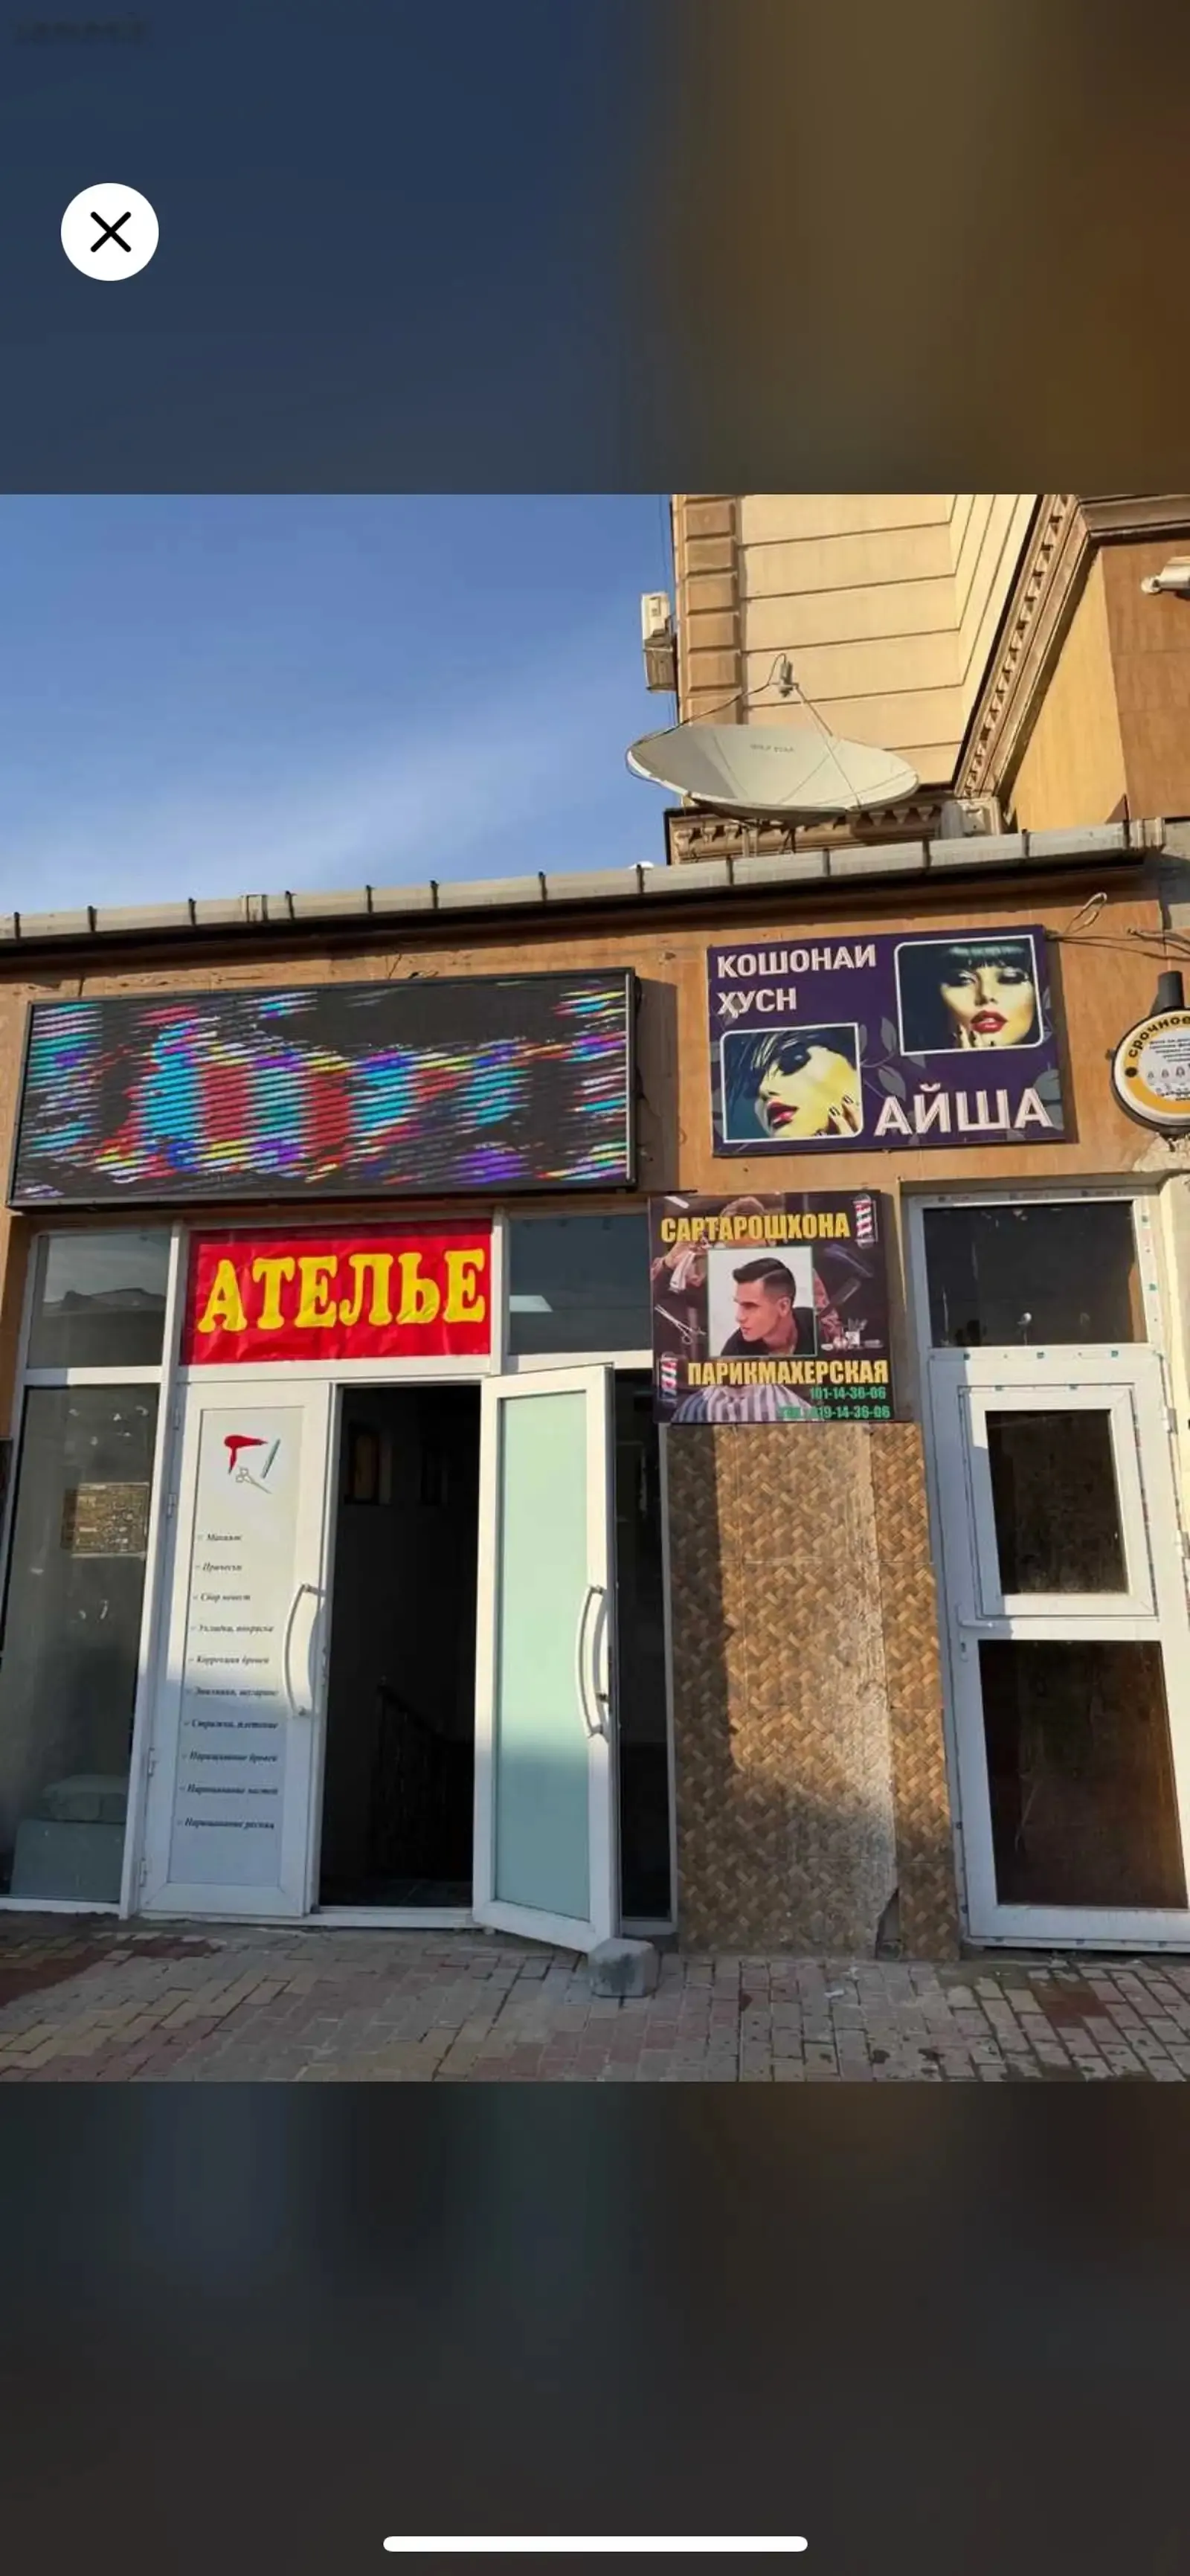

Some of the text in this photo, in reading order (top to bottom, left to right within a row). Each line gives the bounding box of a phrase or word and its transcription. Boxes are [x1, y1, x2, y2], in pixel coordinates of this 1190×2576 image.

[717, 944, 876, 978] КОШОНАИ
[873, 1082, 1054, 1137] АЙША
[198, 1249, 485, 1333] АТЕЛЬЕ
[687, 1360, 889, 1385] ПАРИКМАХЕРСКАЯ
